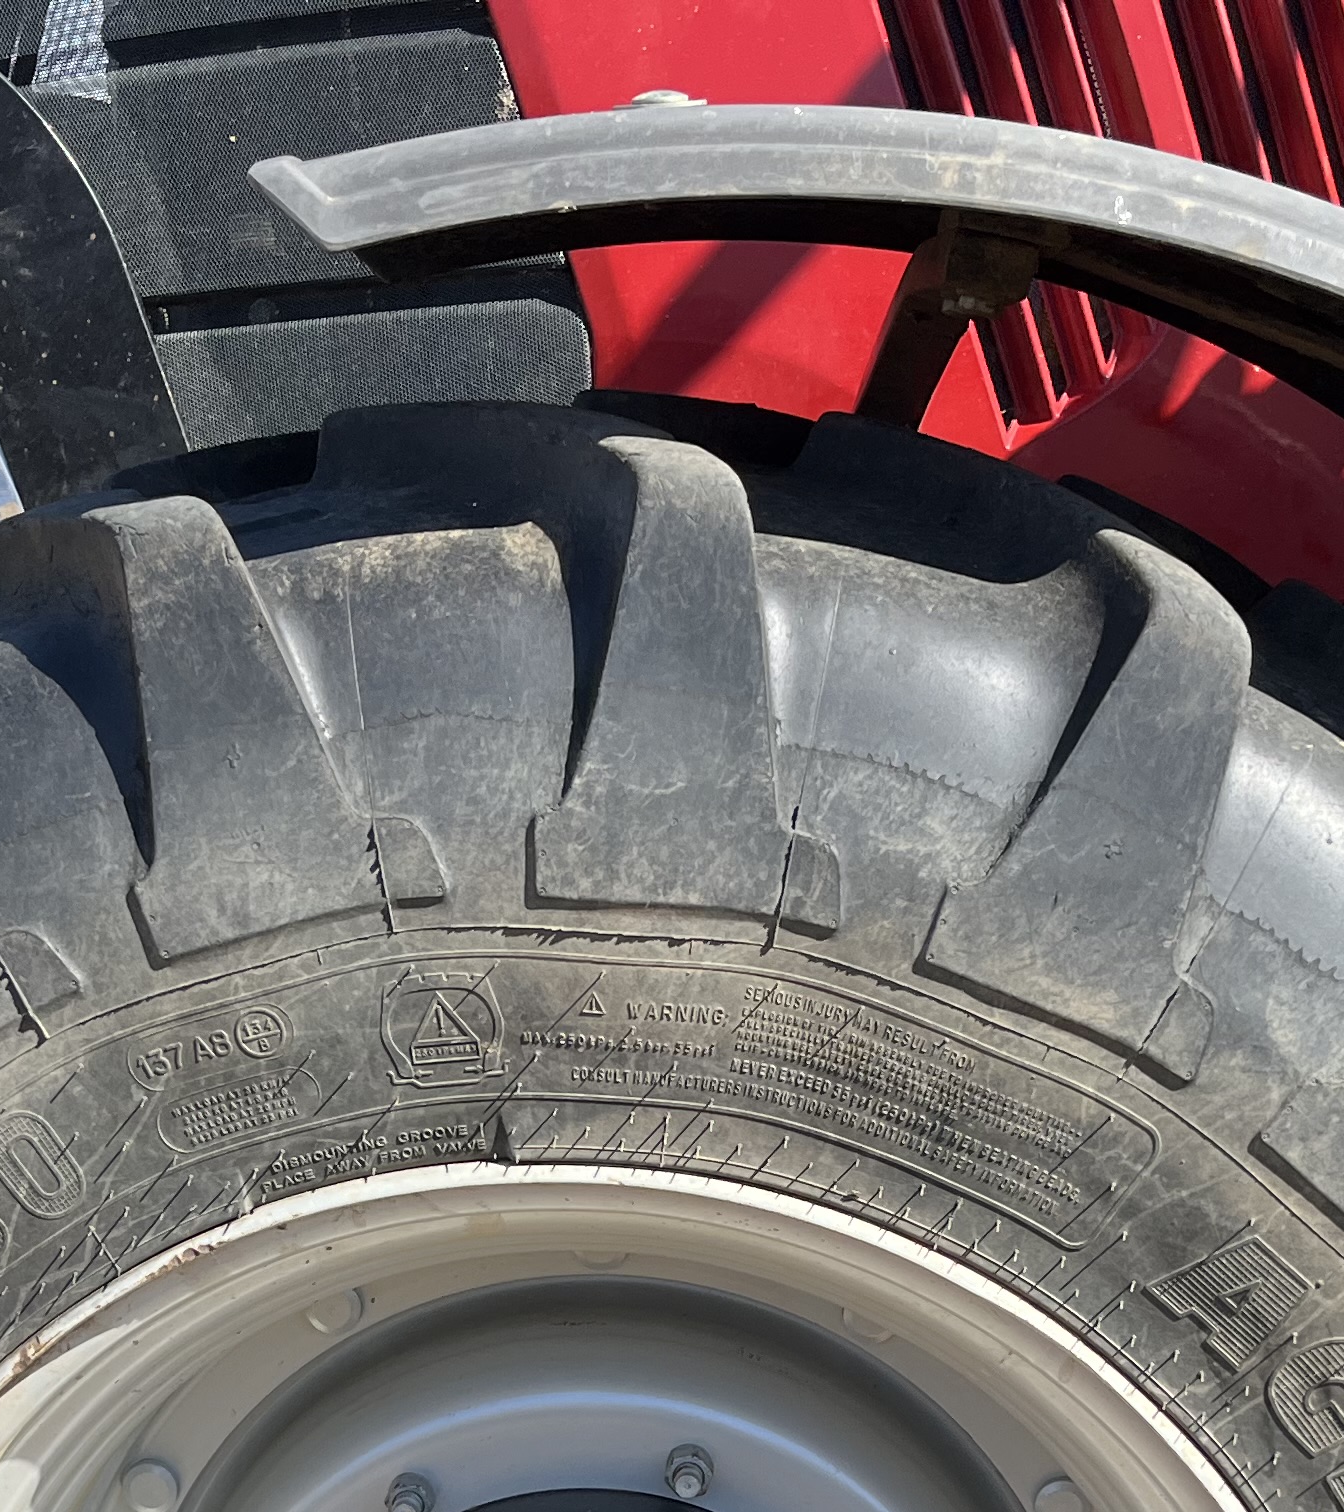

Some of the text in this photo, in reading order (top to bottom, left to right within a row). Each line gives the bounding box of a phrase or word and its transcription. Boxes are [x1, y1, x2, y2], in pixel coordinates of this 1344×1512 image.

[133, 1027, 234, 1082] 137 A8
[240, 1016, 274, 1039] 134
[742, 982, 977, 1075] SERIOUS INJURY MAY RESULT FROM
[570, 1066, 632, 1086] CONSULT
[633, 1069, 742, 1097] MANUFACTURERS
[739, 1080, 834, 1120] INSTRUCTIONS
[831, 1105, 860, 1127] FOR
[857, 1116, 932, 1158] ADDITIONAL
[728, 1054, 777, 1083] NEVER
[775, 1066, 831, 1096] EXCEED
[976, 1142, 1040, 1182] SEATING
[260, 1137, 487, 1194] PLACE AWAY FROM VALVE
[269, 1120, 469, 1174] DISMOUNTING GROOVE
